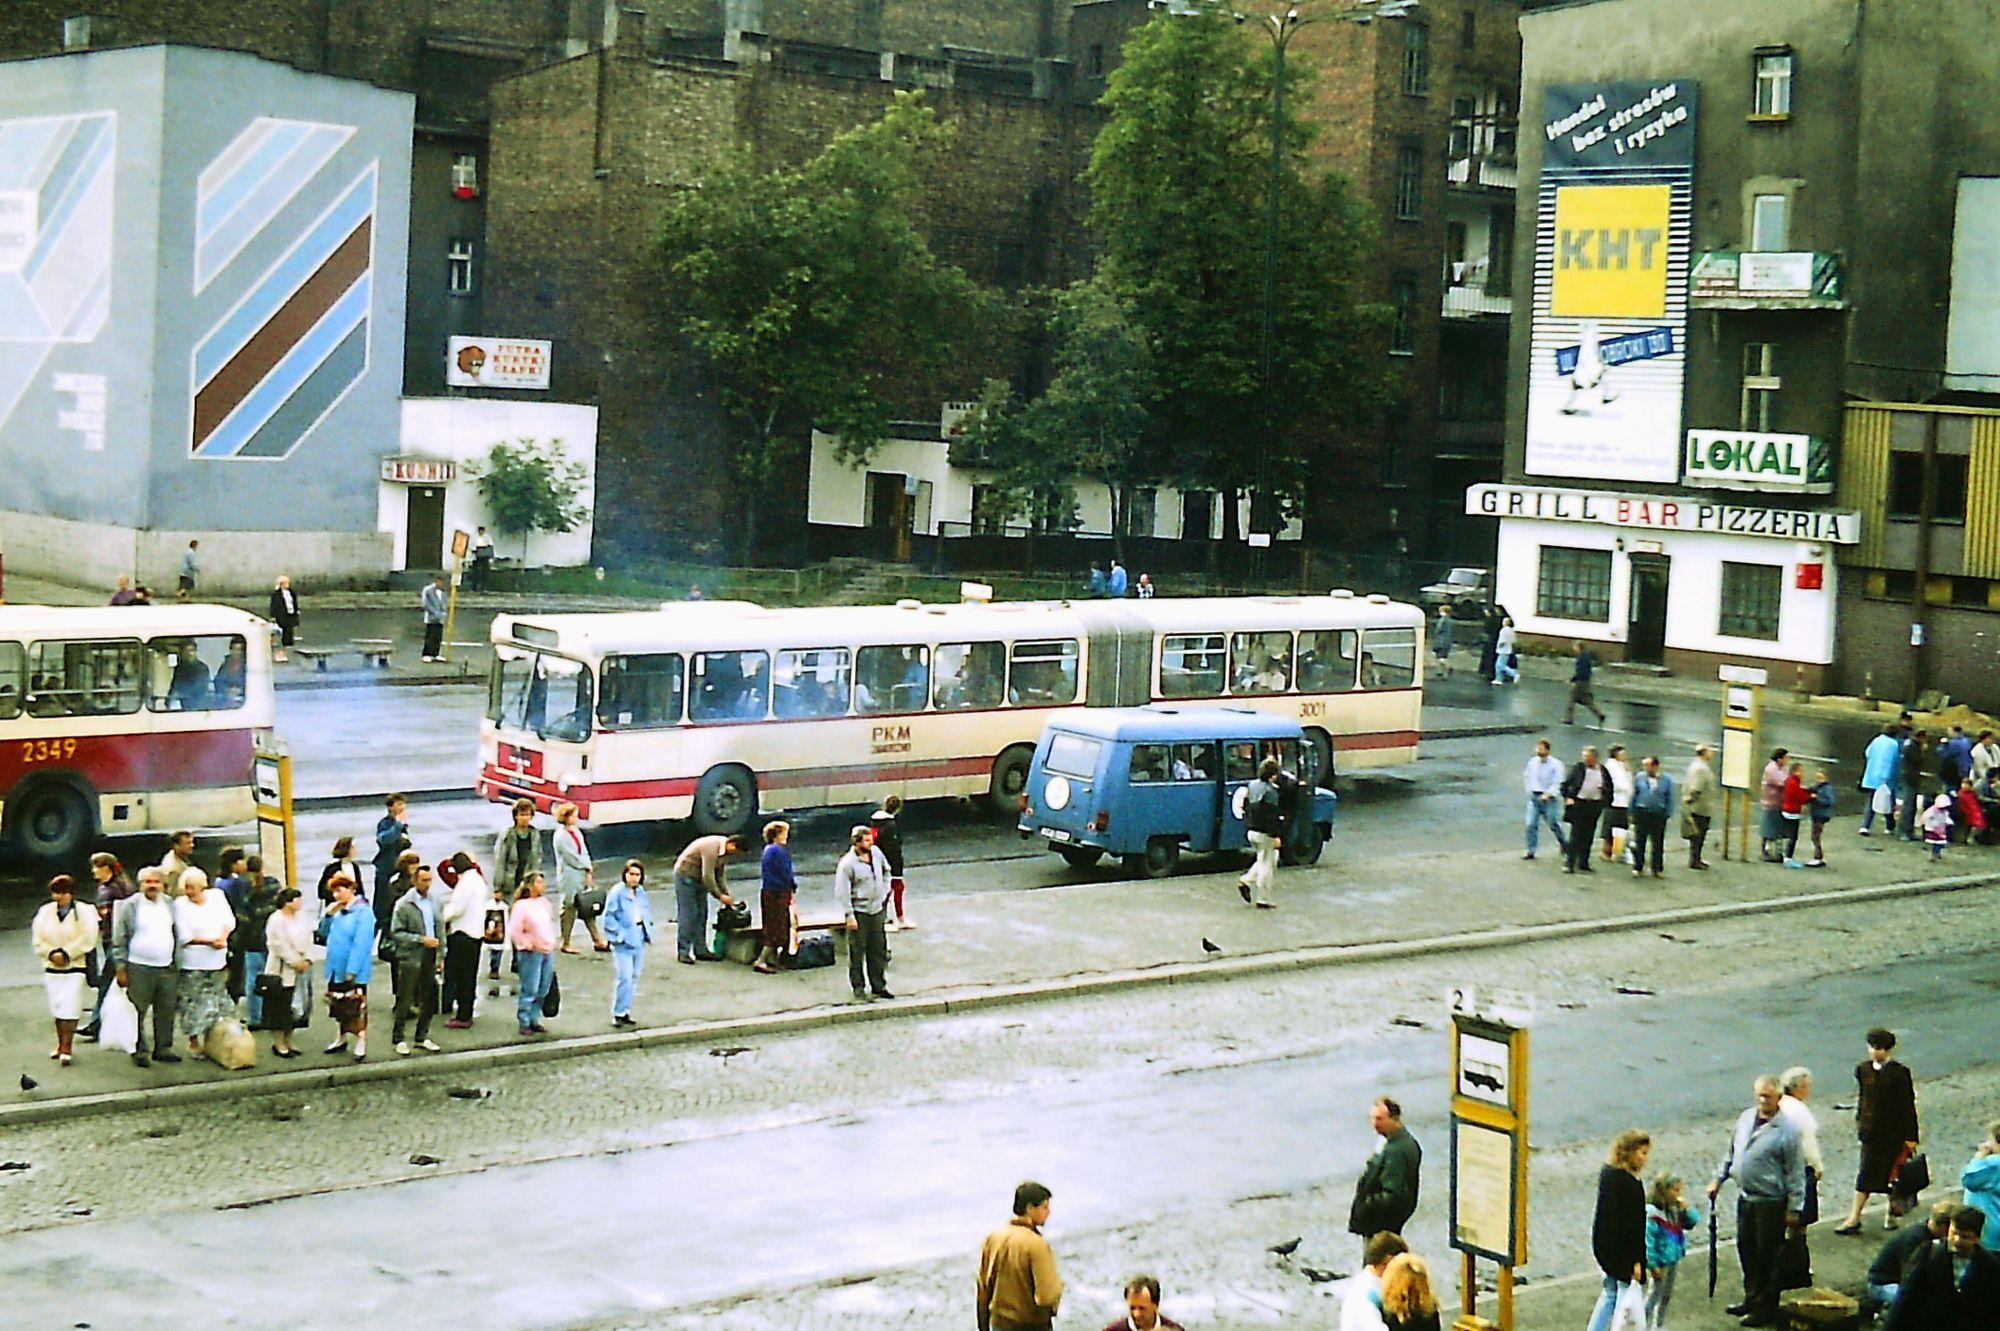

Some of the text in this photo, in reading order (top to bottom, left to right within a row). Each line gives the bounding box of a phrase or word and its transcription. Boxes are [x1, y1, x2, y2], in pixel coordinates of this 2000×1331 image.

[1546, 94, 1606, 140] Handel
[1572, 84, 1676, 152] bez stresów
[1614, 138, 1624, 155] i
[1560, 228, 1661, 270] KHT
[1690, 437, 1800, 476] LOKAL
[1481, 490, 1840, 540] GRILL BAR PIZZERIA
[1300, 702, 1326, 718] 3001
[872, 726, 911, 741] PKM
[22, 738, 77, 762] 2349
[1453, 989, 1463, 1011] 2
